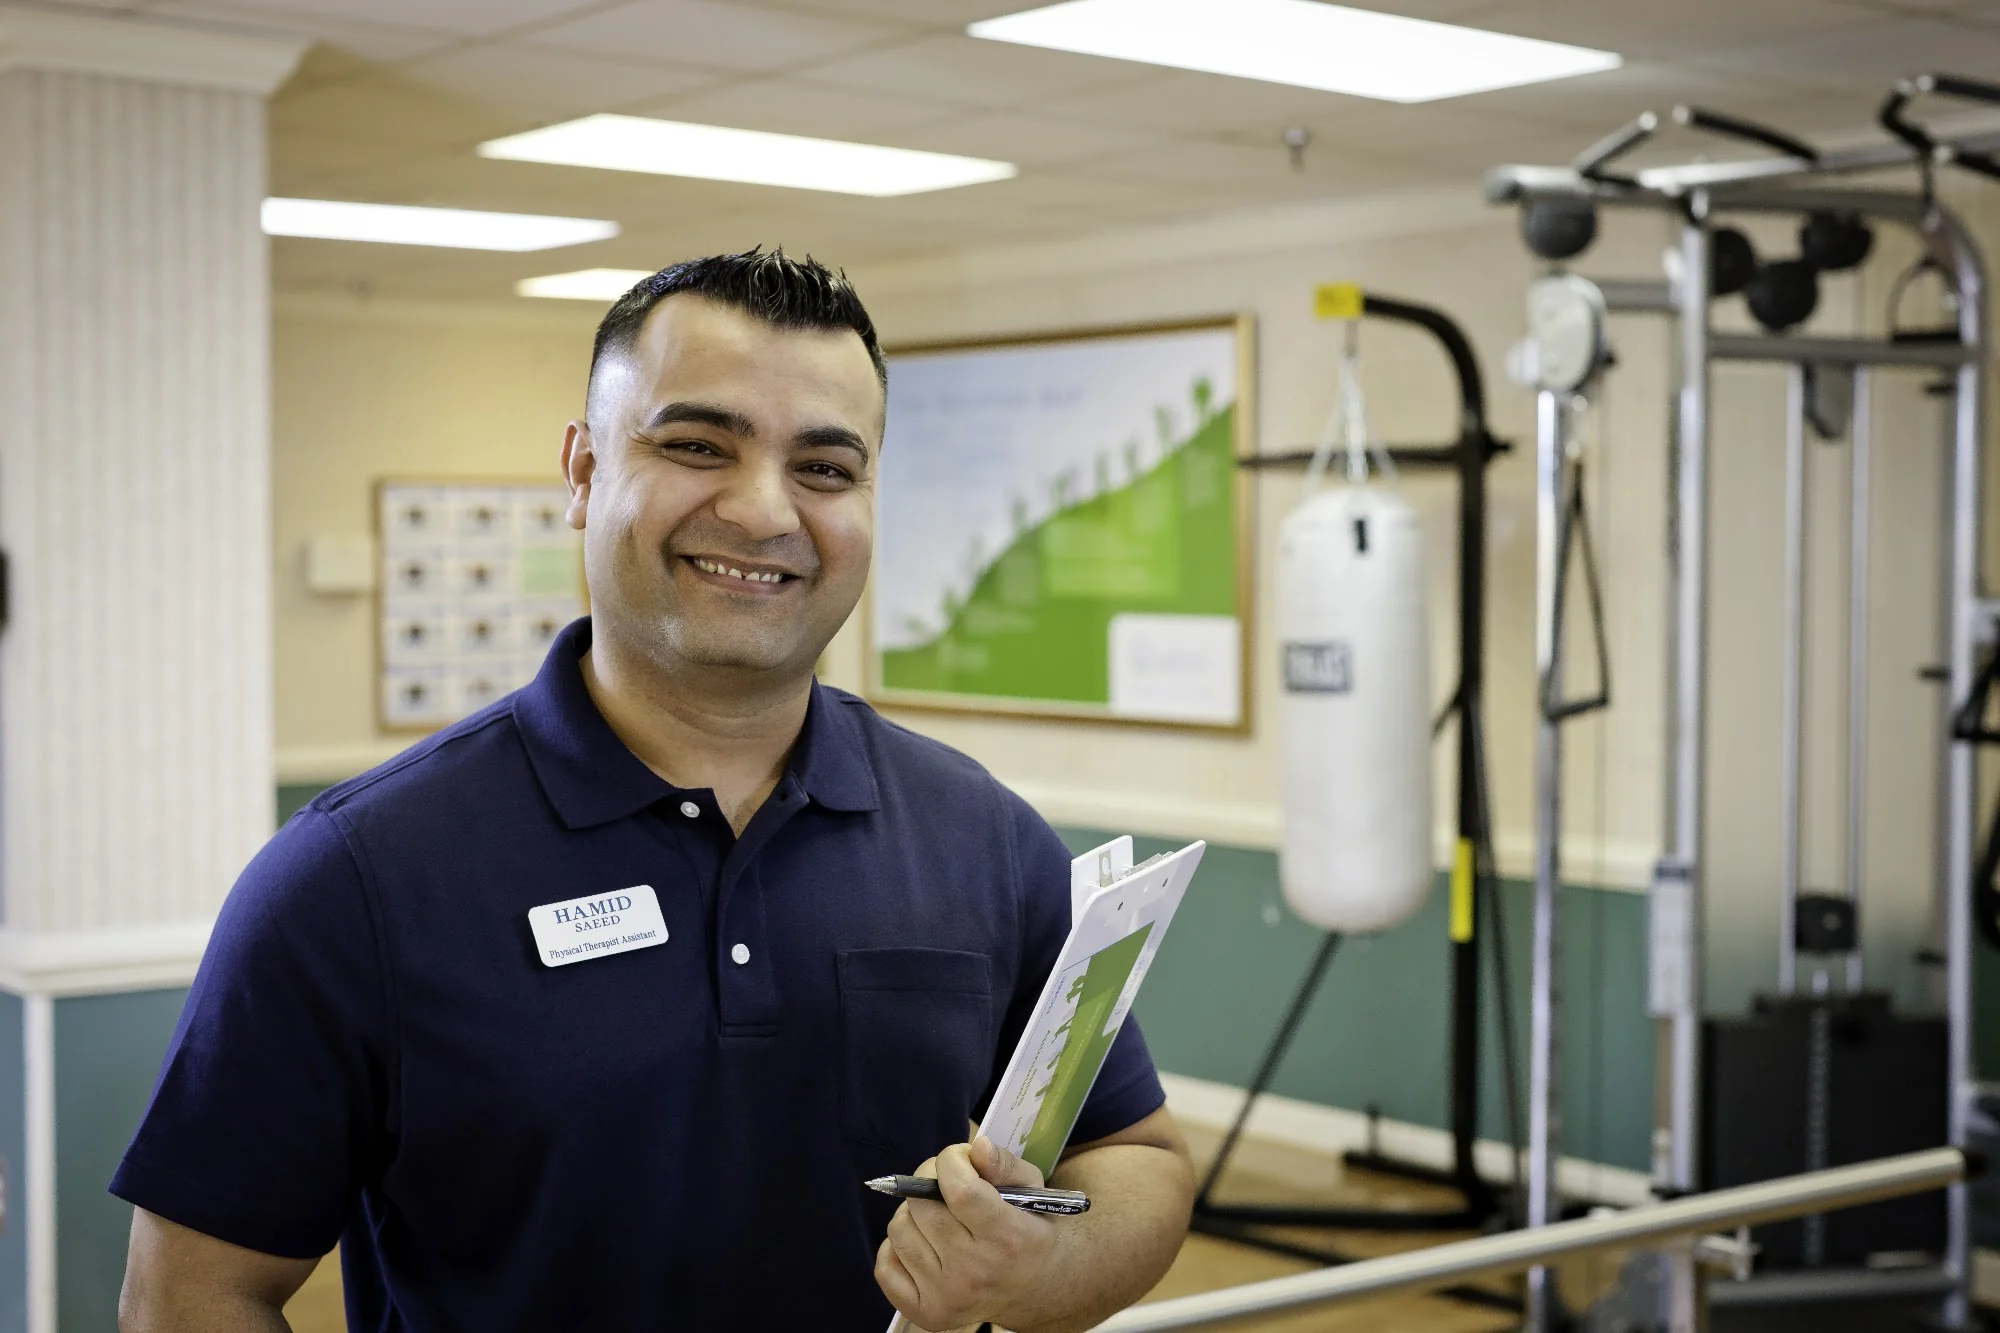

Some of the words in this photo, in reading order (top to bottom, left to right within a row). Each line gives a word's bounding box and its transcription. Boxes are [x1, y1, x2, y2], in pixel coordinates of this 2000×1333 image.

[553, 895, 632, 924] HAMID
[575, 914, 621, 933] SAEED
[549, 944, 583, 959] Physical
[583, 937, 620, 952] Therapist
[621, 930, 657, 944] Assistant
[1010, 1029, 1051, 1112] Community
